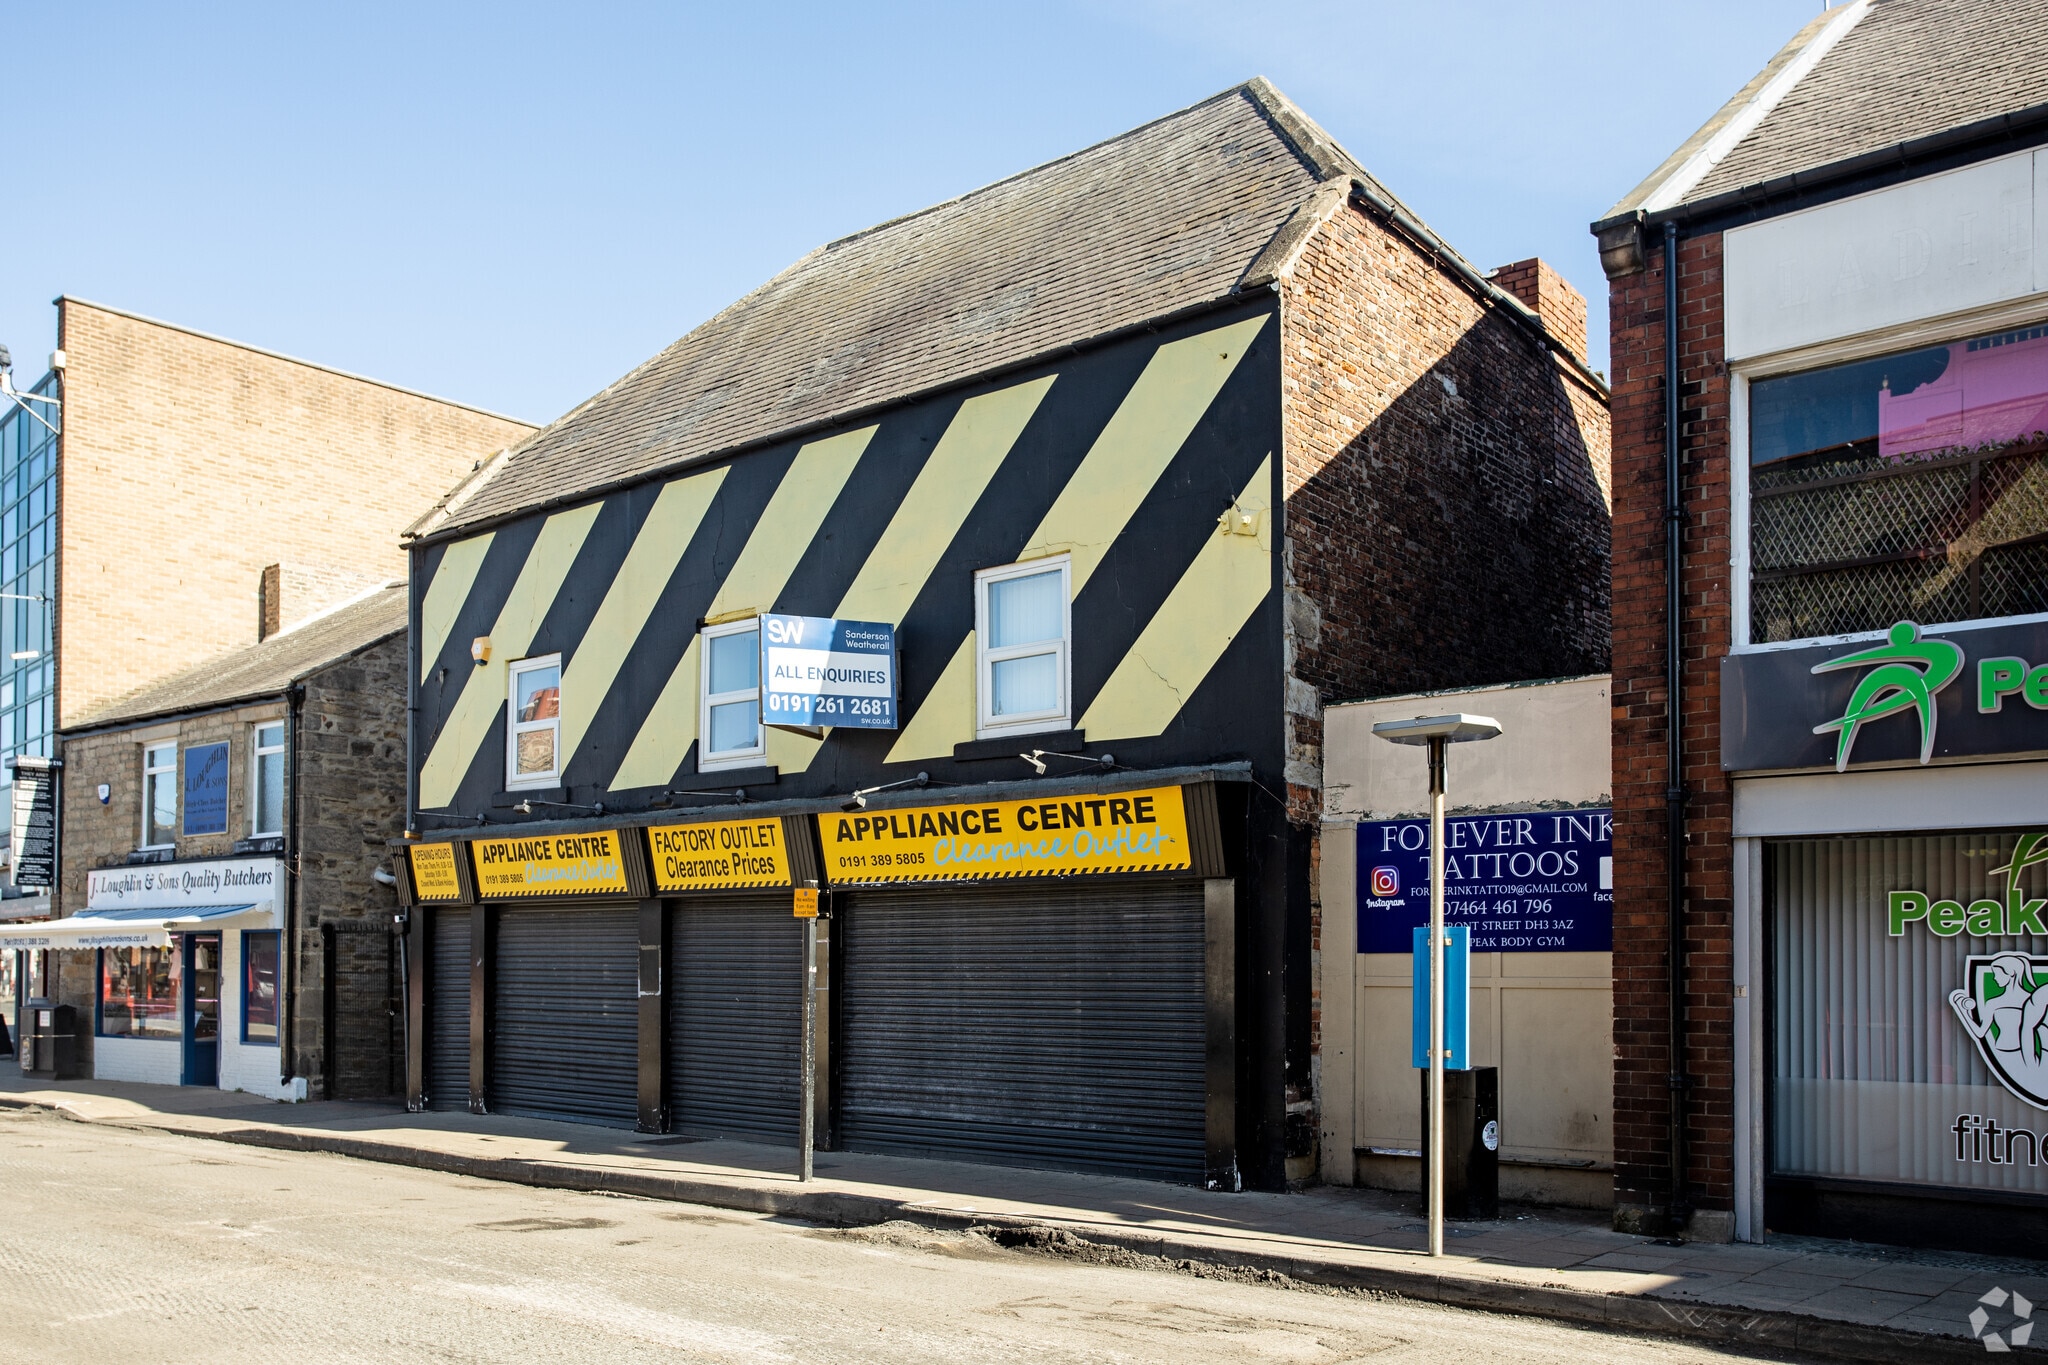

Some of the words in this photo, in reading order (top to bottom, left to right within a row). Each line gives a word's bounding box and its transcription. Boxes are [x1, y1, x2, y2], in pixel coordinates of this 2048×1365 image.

[768, 620, 804, 644] SW
[846, 630, 889, 640] Sanderson
[846, 640, 889, 650] Weatherall
[775, 665, 802, 679] ALL
[808, 667, 885, 683] ENQUIRIES
[769, 694, 810, 712] 0191
[816, 697, 844, 714] 261
[851, 699, 889, 715] 2681
[837, 808, 1002, 842] APPLIANCE
[1017, 796, 1156, 832] CENTRE
[1552, 814, 1612, 843] INK
[482, 840, 552, 864] APPLIANCE
[556, 836, 610, 861] CENTRE
[655, 828, 718, 854] FACTORY
[720, 824, 776, 850] OUTLET
[934, 837, 1071, 866] Clearance
[1073, 826, 1170, 859] Outlet
[415, 849, 434, 861] OPENING
[434, 848, 451, 859] HOURS
[666, 854, 729, 879] Clearance
[733, 852, 775, 875] Prices
[839, 855, 867, 868] 0191
[870, 854, 892, 866] 389
[896, 852, 925, 866] 5805
[1419, 850, 1579, 881] TATTOOS
[485, 874, 498, 884] 0191
[499, 874, 510, 883] 389
[510, 873, 523, 883] 5805
[525, 861, 581, 885] Clearance
[581, 858, 619, 881] Outlet
[90, 877, 98, 900] J.
[101, 874, 142, 898] Loughlin
[144, 873, 155, 890] &
[157, 873, 179, 890] Sons
[182, 870, 221, 895] Quality
[224, 866, 272, 887] Butchers
[1410, 883, 1588, 897] FORERINKTATTO19@GMAIL.COM
[1366, 898, 1405, 911] Instagram
[1443, 900, 1487, 915] 07464
[1493, 900, 1517, 914] 461
[1523, 899, 1552, 913] 796
[1888, 888, 2048, 937] Peak
[1482, 920, 1522, 930] STREET
[1525, 920, 1549, 929] DH3
[1552, 920, 1574, 929] 3AZ
[1470, 938, 1497, 947] PEAK
[1501, 937, 1532, 946] BODY
[1537, 936, 1565, 946] GYM
[1951, 1113, 2048, 1166] fitn
